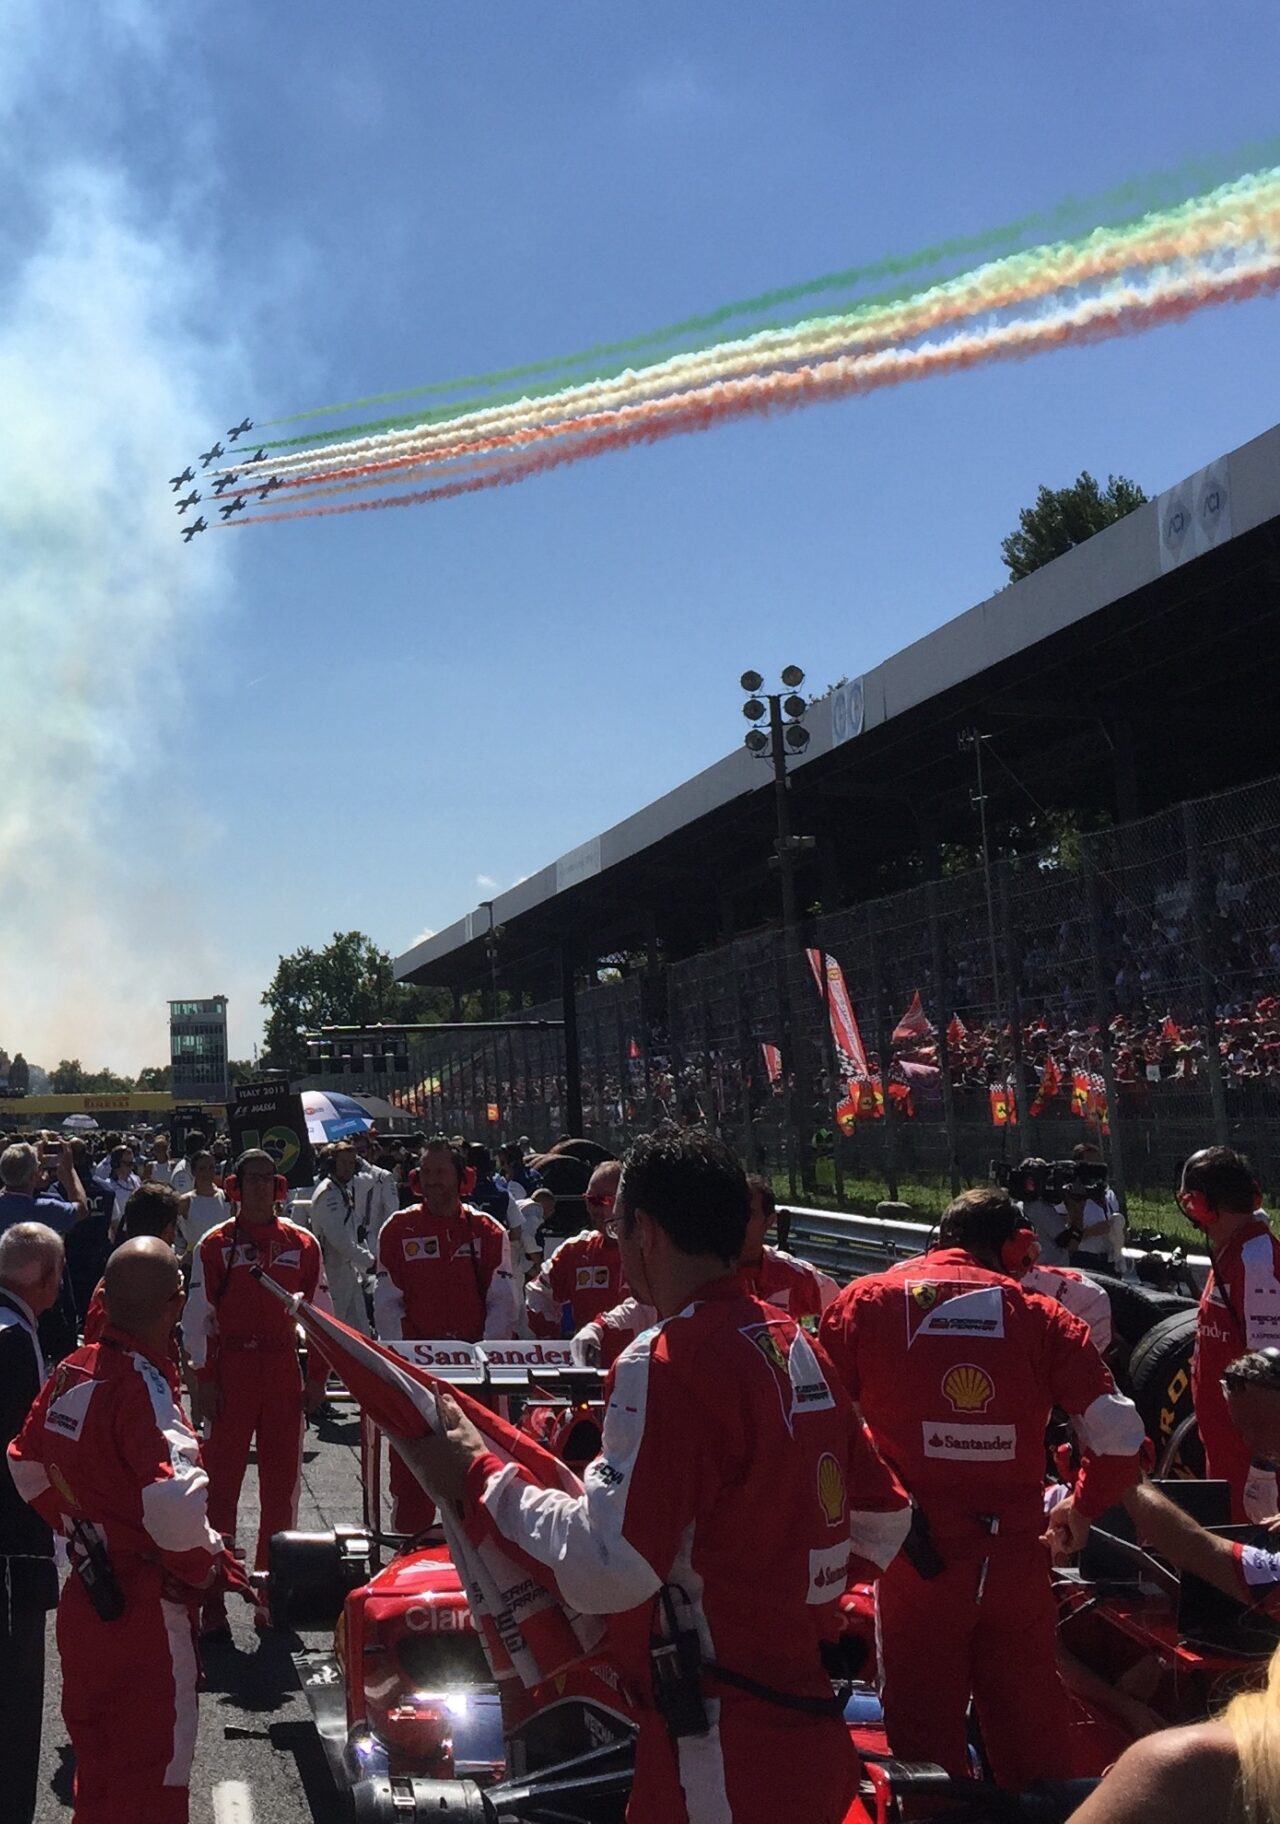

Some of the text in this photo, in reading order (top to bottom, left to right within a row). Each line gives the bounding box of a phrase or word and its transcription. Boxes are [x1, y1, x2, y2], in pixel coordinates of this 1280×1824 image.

[263, 1085, 286, 1096] 2015
[251, 1102, 277, 1113] MASSA
[414, 1344, 576, 1367] Sanander
[944, 1435, 1013, 1450] Santander
